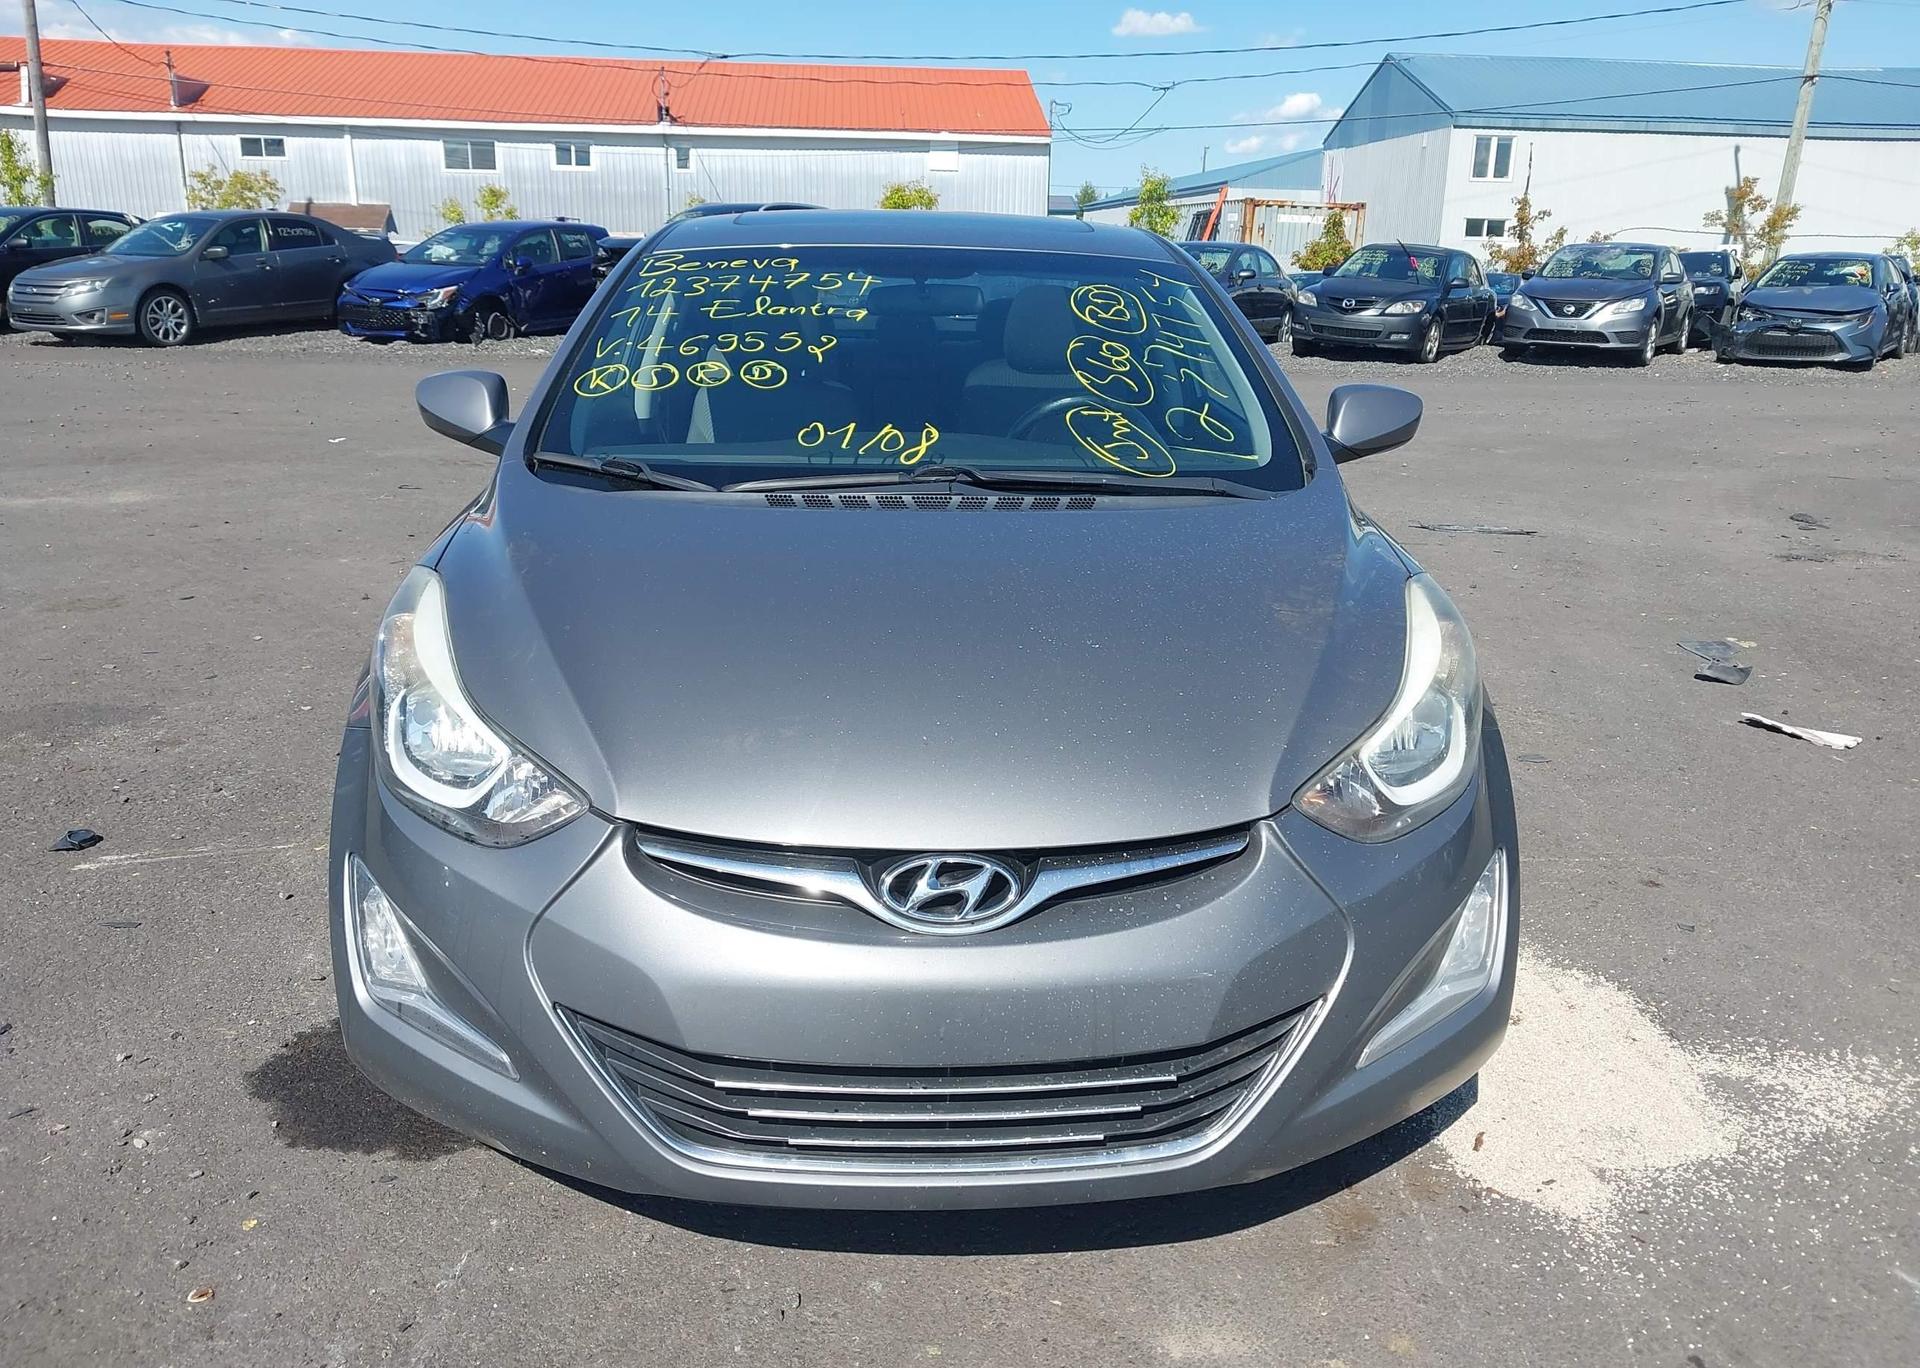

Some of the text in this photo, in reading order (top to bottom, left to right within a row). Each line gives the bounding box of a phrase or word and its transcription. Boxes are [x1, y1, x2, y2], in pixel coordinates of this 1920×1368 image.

[639, 253, 800, 276] Beneva
[627, 272, 883, 298] 12374754
[610, 295, 870, 328] 14 Elantra
[797, 422, 940, 465] 01/08
